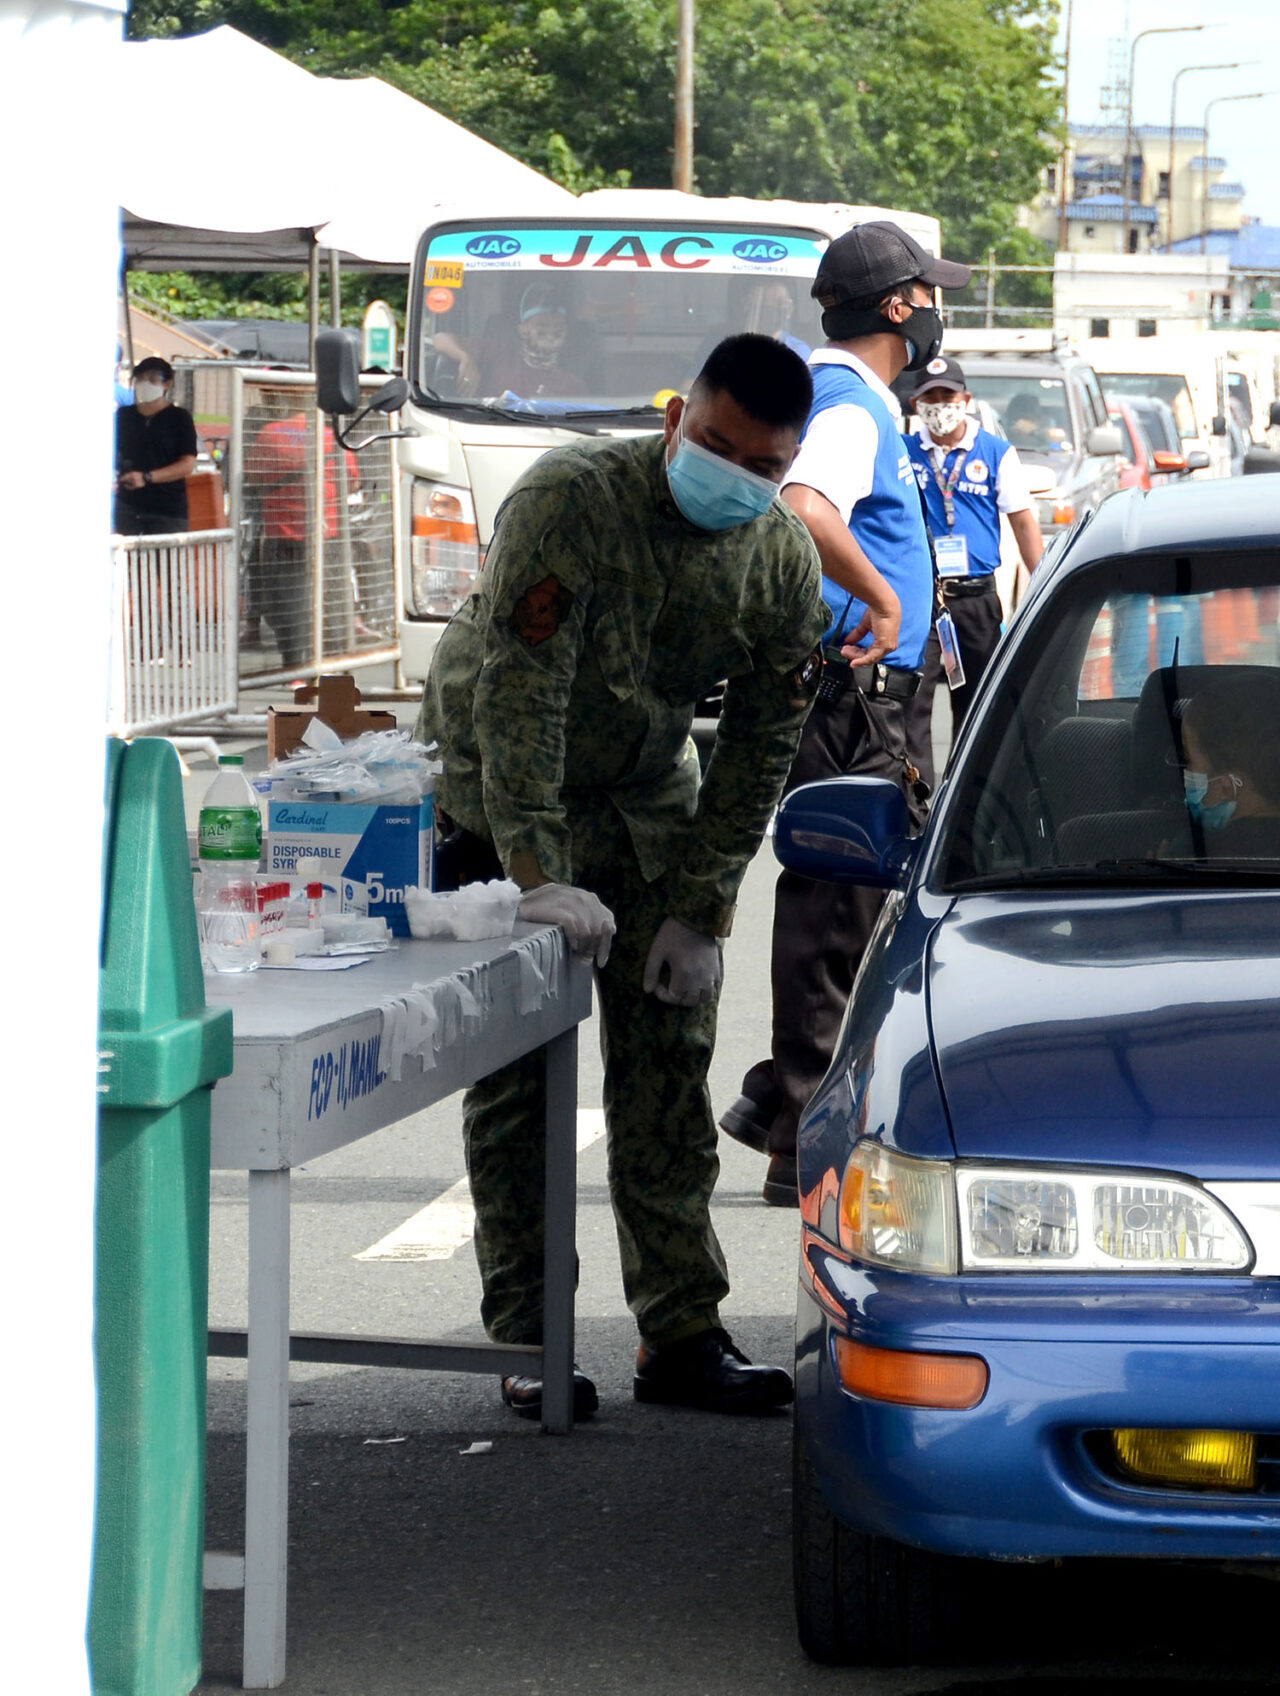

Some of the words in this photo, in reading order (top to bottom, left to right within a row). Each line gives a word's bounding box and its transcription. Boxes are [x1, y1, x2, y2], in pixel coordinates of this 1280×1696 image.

[468, 240, 519, 254] JAC
[539, 235, 715, 269] JAC
[735, 243, 786, 259] JAC
[275, 808, 329, 824] Cardinal
[272, 845, 341, 859] DISPOSABLE
